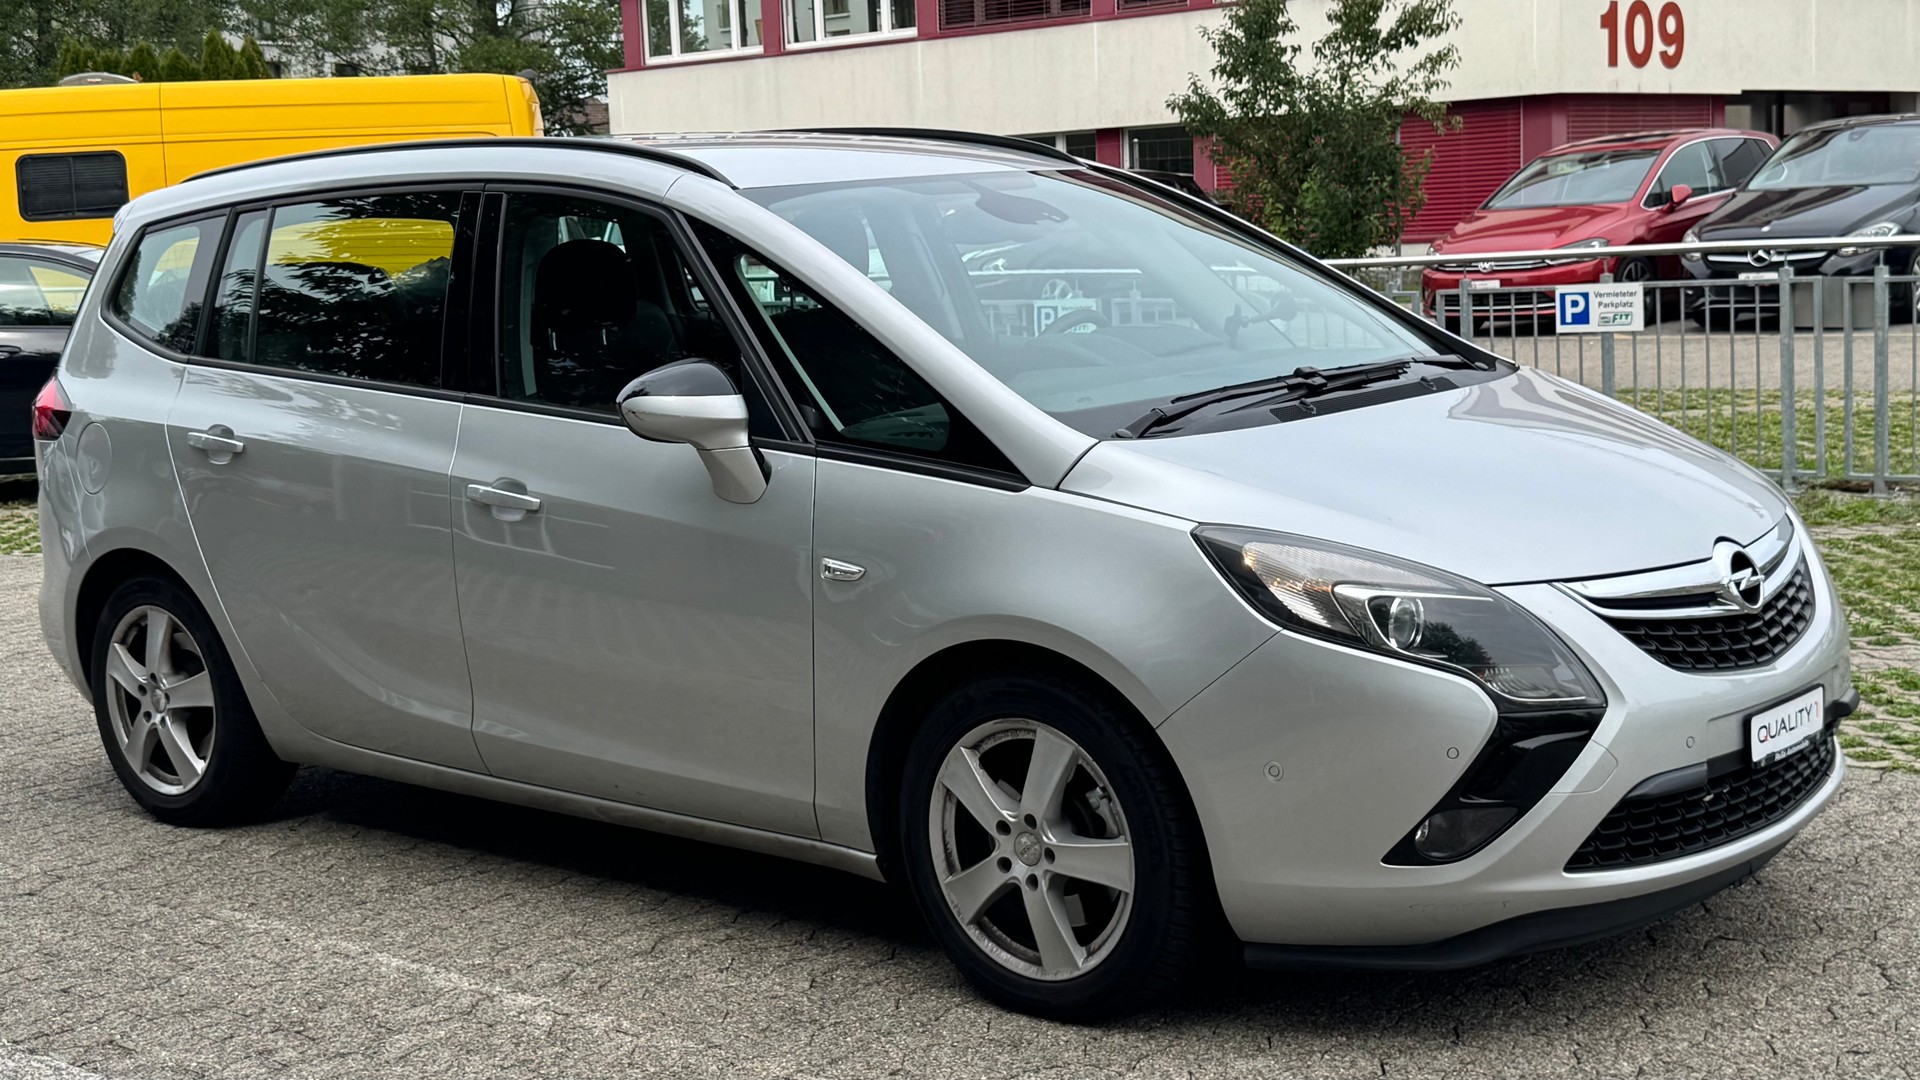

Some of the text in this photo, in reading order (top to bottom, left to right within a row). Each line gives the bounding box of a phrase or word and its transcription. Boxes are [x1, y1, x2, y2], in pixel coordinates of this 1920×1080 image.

[1600, 0, 1684, 69] 109
[1565, 294, 1585, 323] P
[1598, 301, 1633, 309] Parkplatz
[1612, 313, 1630, 323] FIT
